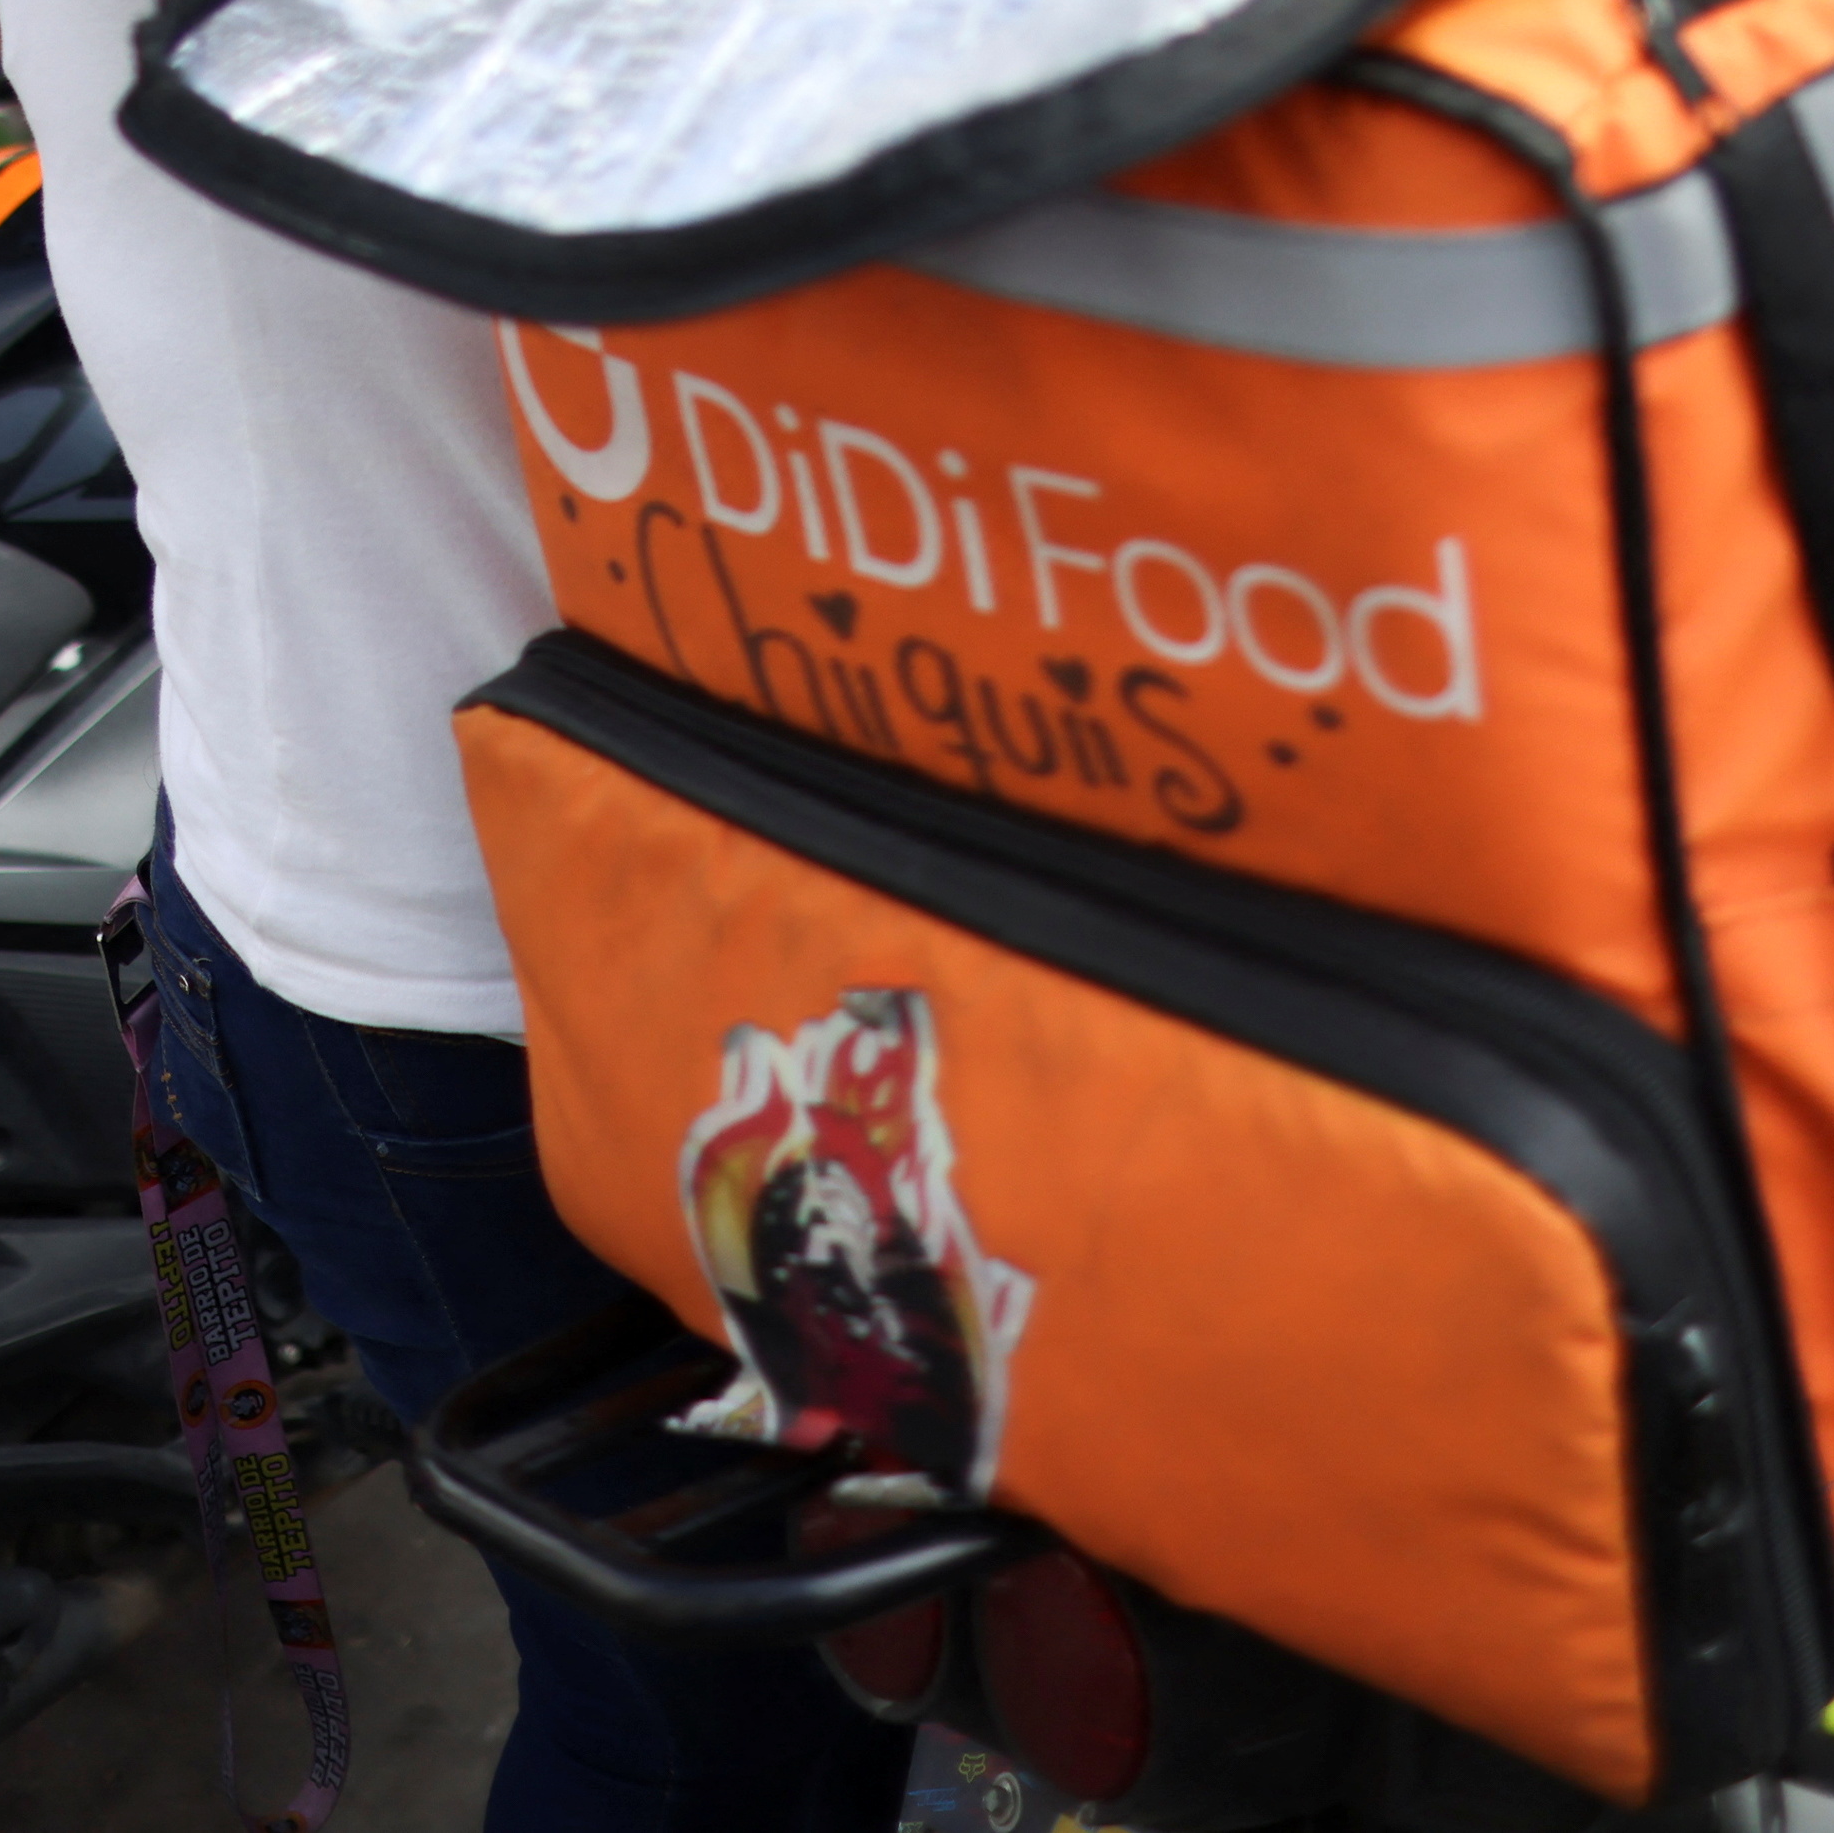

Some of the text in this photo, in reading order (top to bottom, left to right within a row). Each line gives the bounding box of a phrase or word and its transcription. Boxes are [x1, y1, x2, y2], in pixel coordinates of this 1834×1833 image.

[675, 372, 1484, 723] DiDi Food
[177, 1224, 231, 1366] BARRIO DE
[203, 1217, 258, 1353] TEPITO
[234, 1453, 286, 1583] BARRIO DE
[260, 1450, 314, 1578] TEPITO
[315, 1670, 349, 1790] TEPITO
